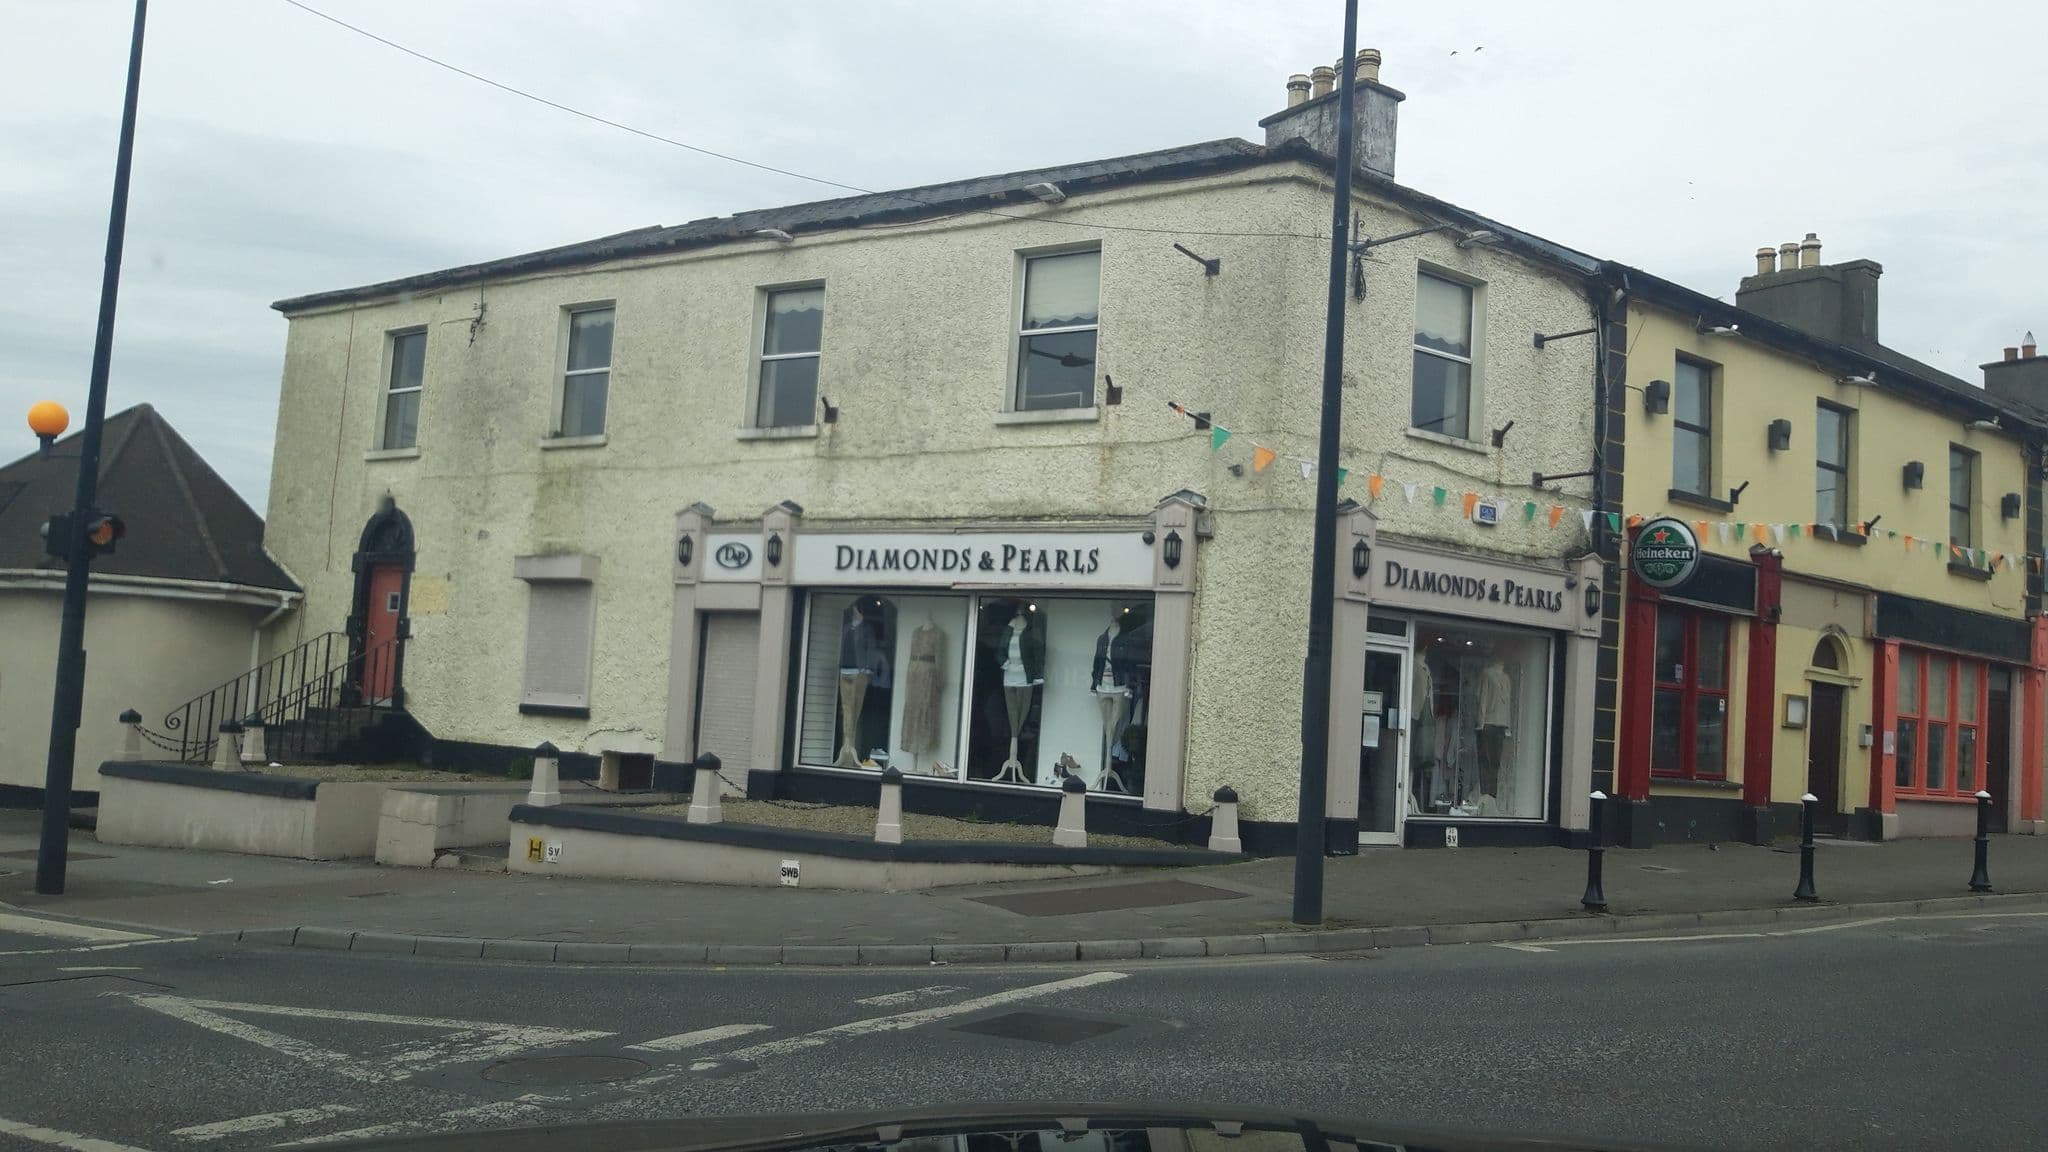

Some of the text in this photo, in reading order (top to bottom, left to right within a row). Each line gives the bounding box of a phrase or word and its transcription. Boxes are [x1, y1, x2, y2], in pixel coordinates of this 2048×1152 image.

[834, 544, 1099, 574] DIAMONDS & PEARLS
[1635, 547, 1690, 559] Heineken
[1385, 560, 1562, 613] DIAMONDS & PEARLS
[529, 839, 542, 860] H
